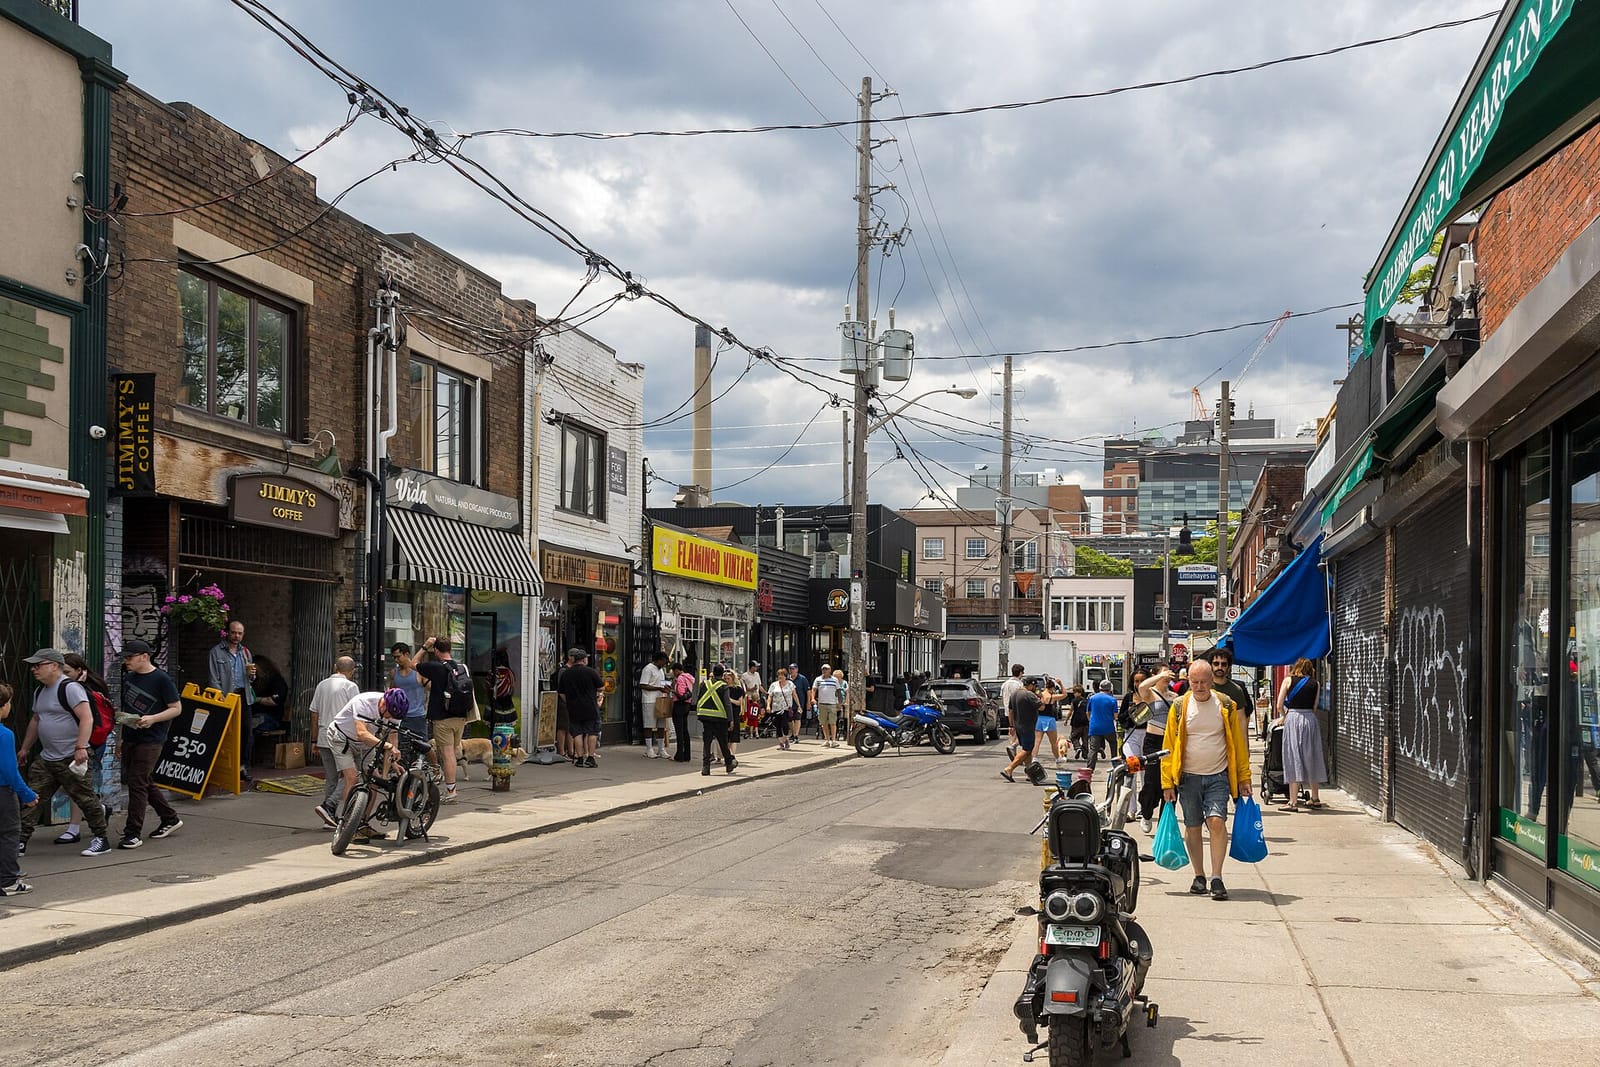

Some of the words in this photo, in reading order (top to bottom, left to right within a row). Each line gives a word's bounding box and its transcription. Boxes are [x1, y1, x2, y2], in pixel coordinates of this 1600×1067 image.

[1380, 193, 1435, 309] CELEBRATING
[1437, 149, 1455, 215] 50
[1460, 37, 1514, 178] YEARS
[1514, 0, 1543, 72] IN
[119, 379, 135, 490] JIMMY'S
[137, 402, 150, 472] COFFEE
[611, 462, 621, 473] FOR
[611, 472, 623, 484] SALE
[260, 482, 317, 508] JIMMY'S
[395, 478, 428, 505] Vida
[272, 506, 303, 521] COFFEE
[434, 494, 457, 507] NATURAL
[458, 500, 468, 510] AND
[468, 502, 489, 516] ORGANIC
[489, 507, 512, 520] PRODUCTS
[546, 552, 587, 583] FLAMINGO
[598, 561, 629, 589] VINTAGE
[677, 540, 720, 576] FLAMINGO
[723, 551, 753, 583] VINTAGE
[156, 759, 205, 785] AMERICANO
